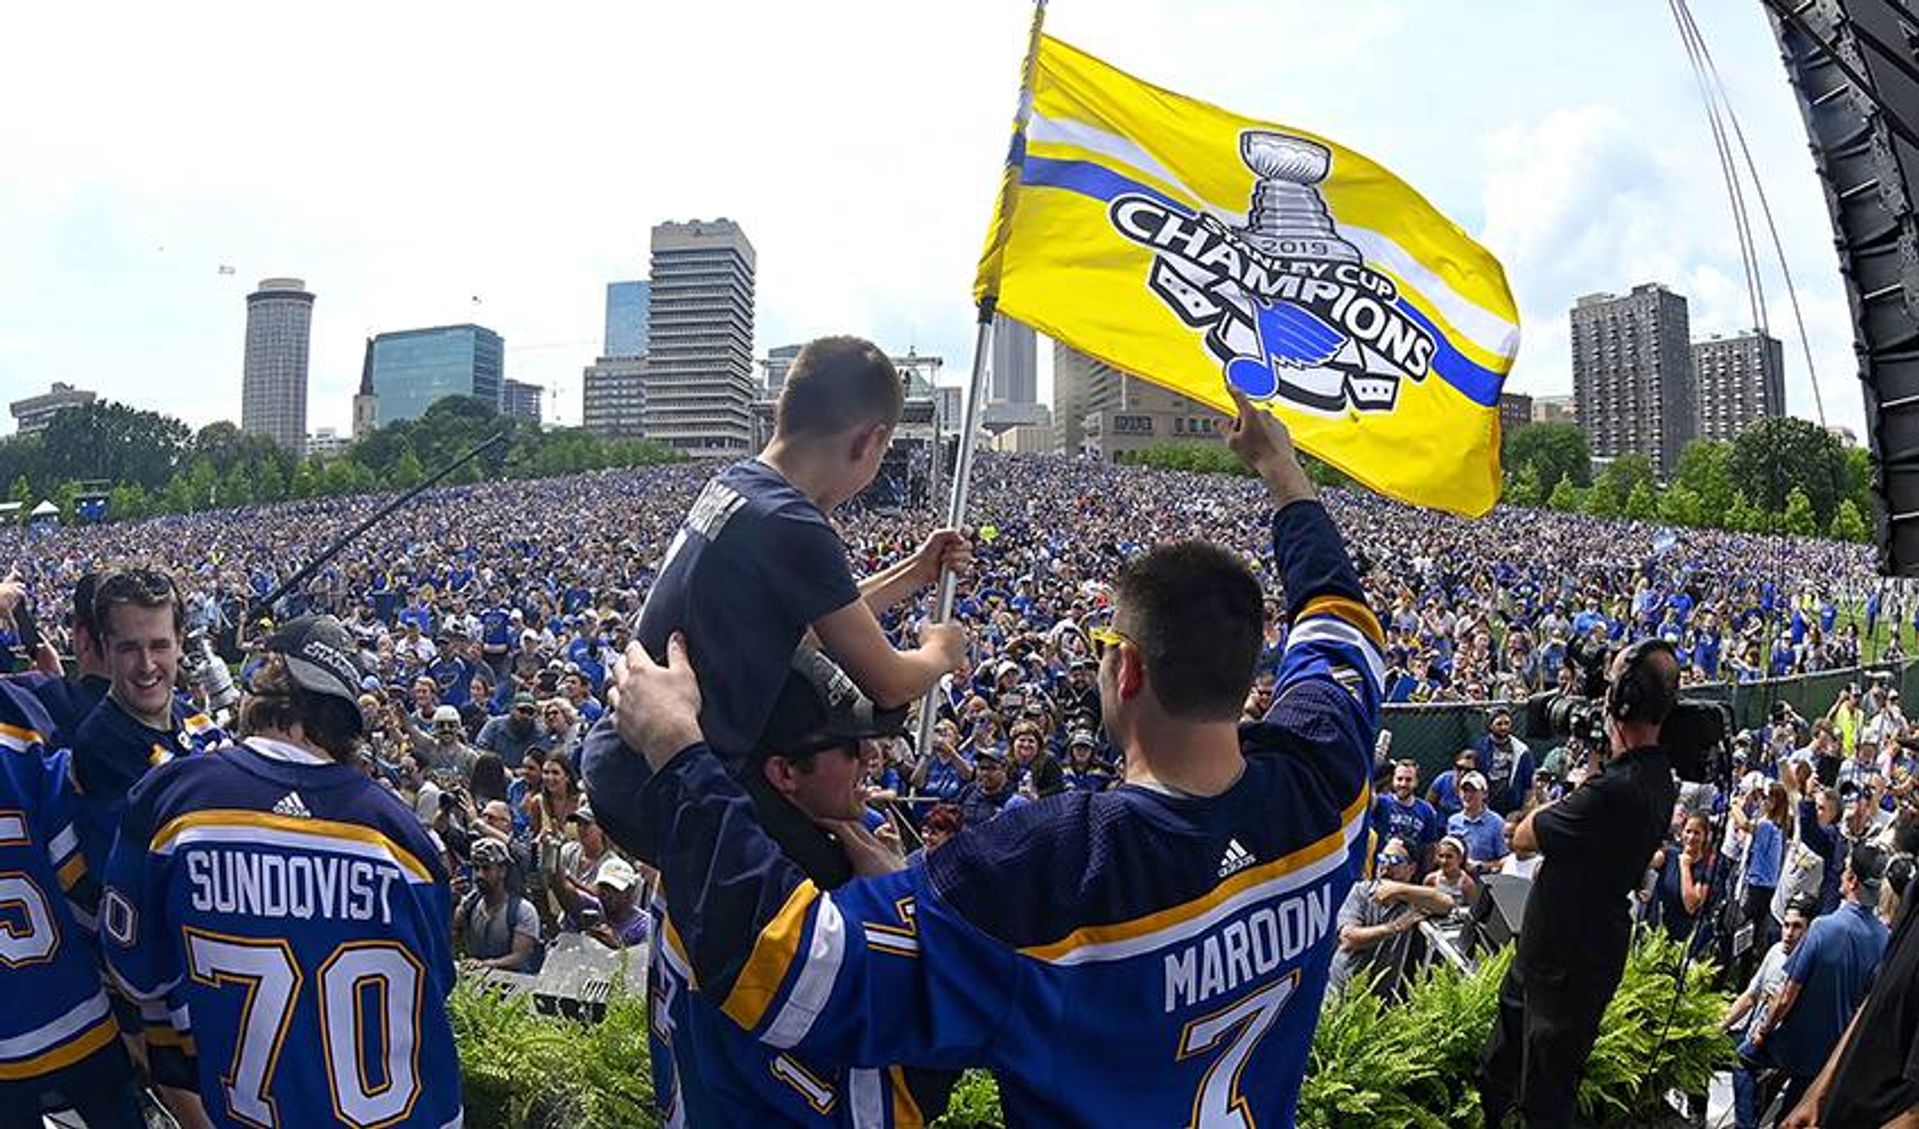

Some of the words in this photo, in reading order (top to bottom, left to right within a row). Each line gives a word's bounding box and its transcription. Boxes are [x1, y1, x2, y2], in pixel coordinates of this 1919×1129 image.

[1115, 200, 1435, 377] CHAMPIONS
[1202, 216, 1329, 278] STANLEY
[1335, 264, 1393, 297] CUP
[1262, 239, 1330, 257] 2019
[186, 850, 400, 924] SUNDQVIST
[1164, 883, 1332, 1013] MAROON
[181, 925, 427, 1129] 70
[1175, 967, 1301, 1129] 7
